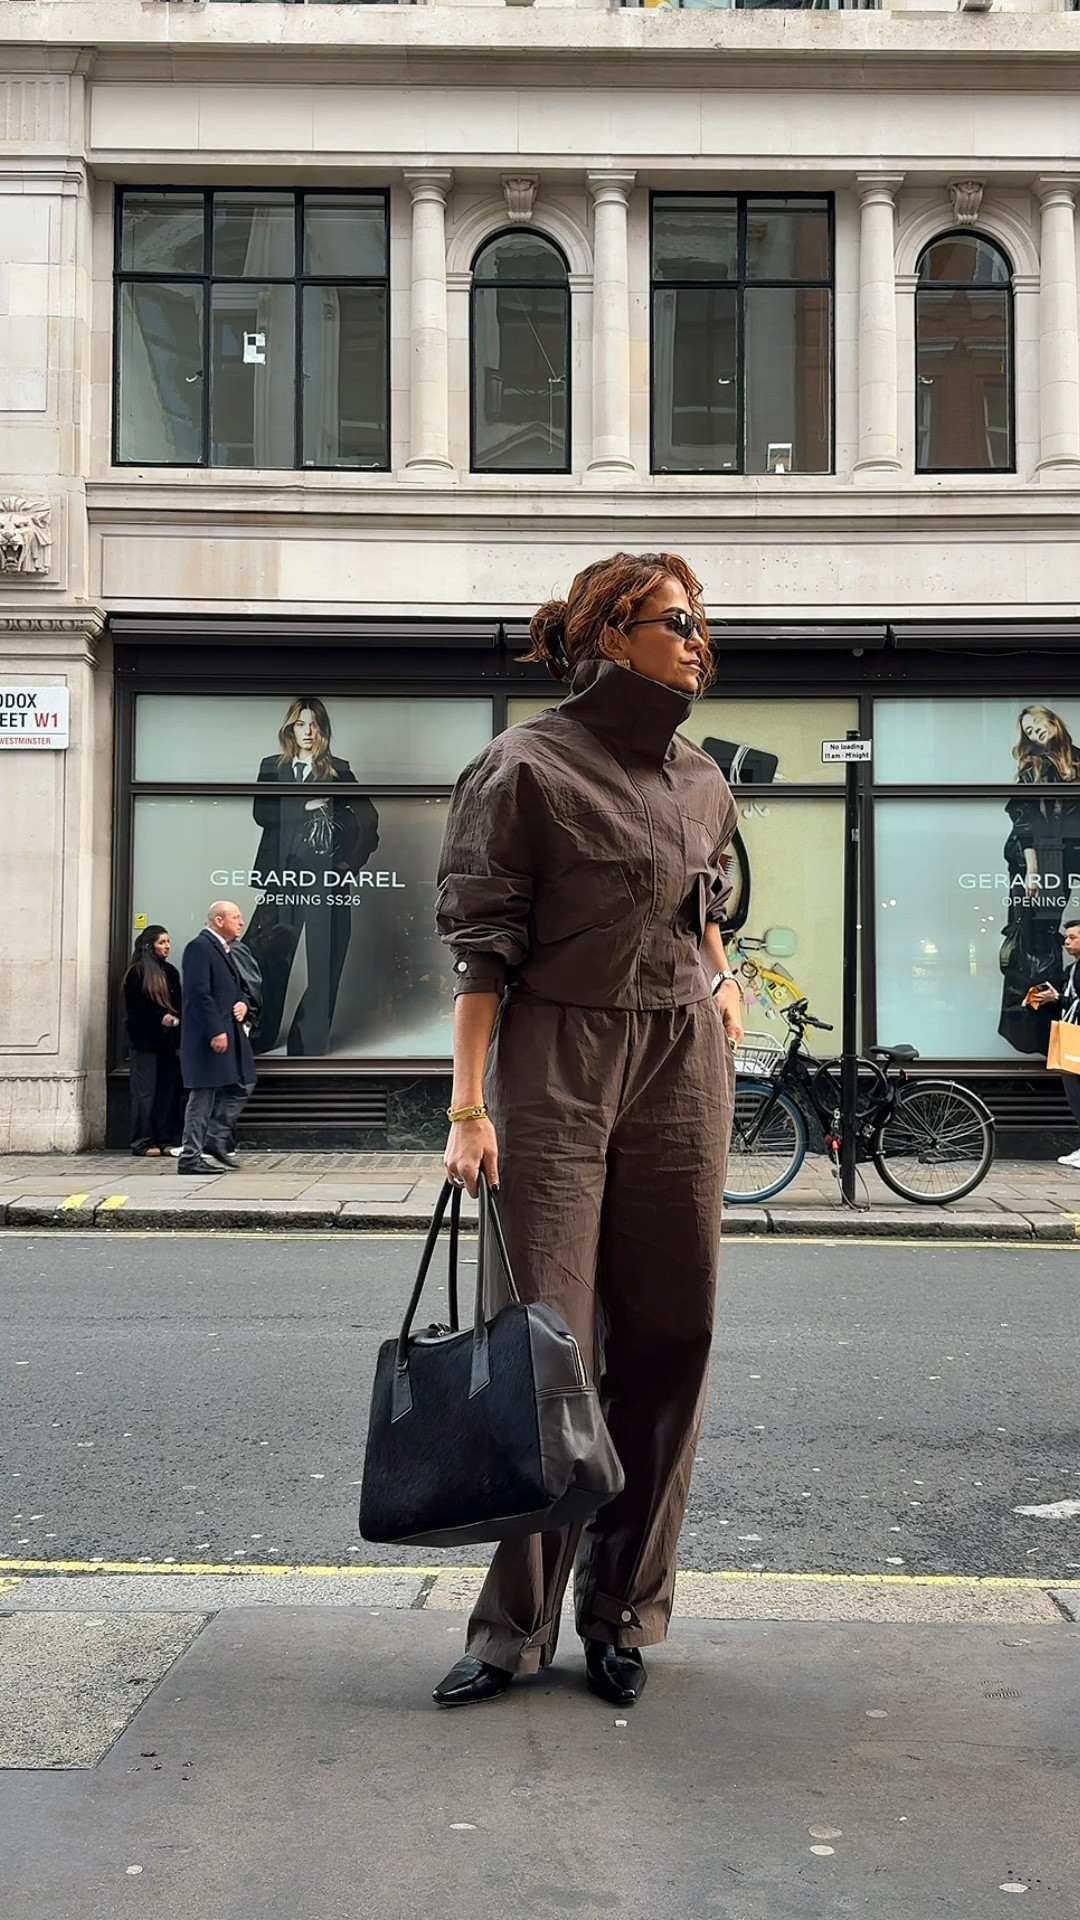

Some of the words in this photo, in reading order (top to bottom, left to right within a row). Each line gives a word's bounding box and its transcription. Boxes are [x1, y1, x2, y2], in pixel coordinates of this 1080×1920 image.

[34, 712, 58, 728] W1
[209, 870, 316, 886] GERARD
[323, 871, 406, 888] DAREL
[958, 873, 1061, 889] GERARD
[254, 894, 321, 906] OPENING
[326, 894, 361, 906] SS26
[1001, 896, 1067, 907] OPENING
